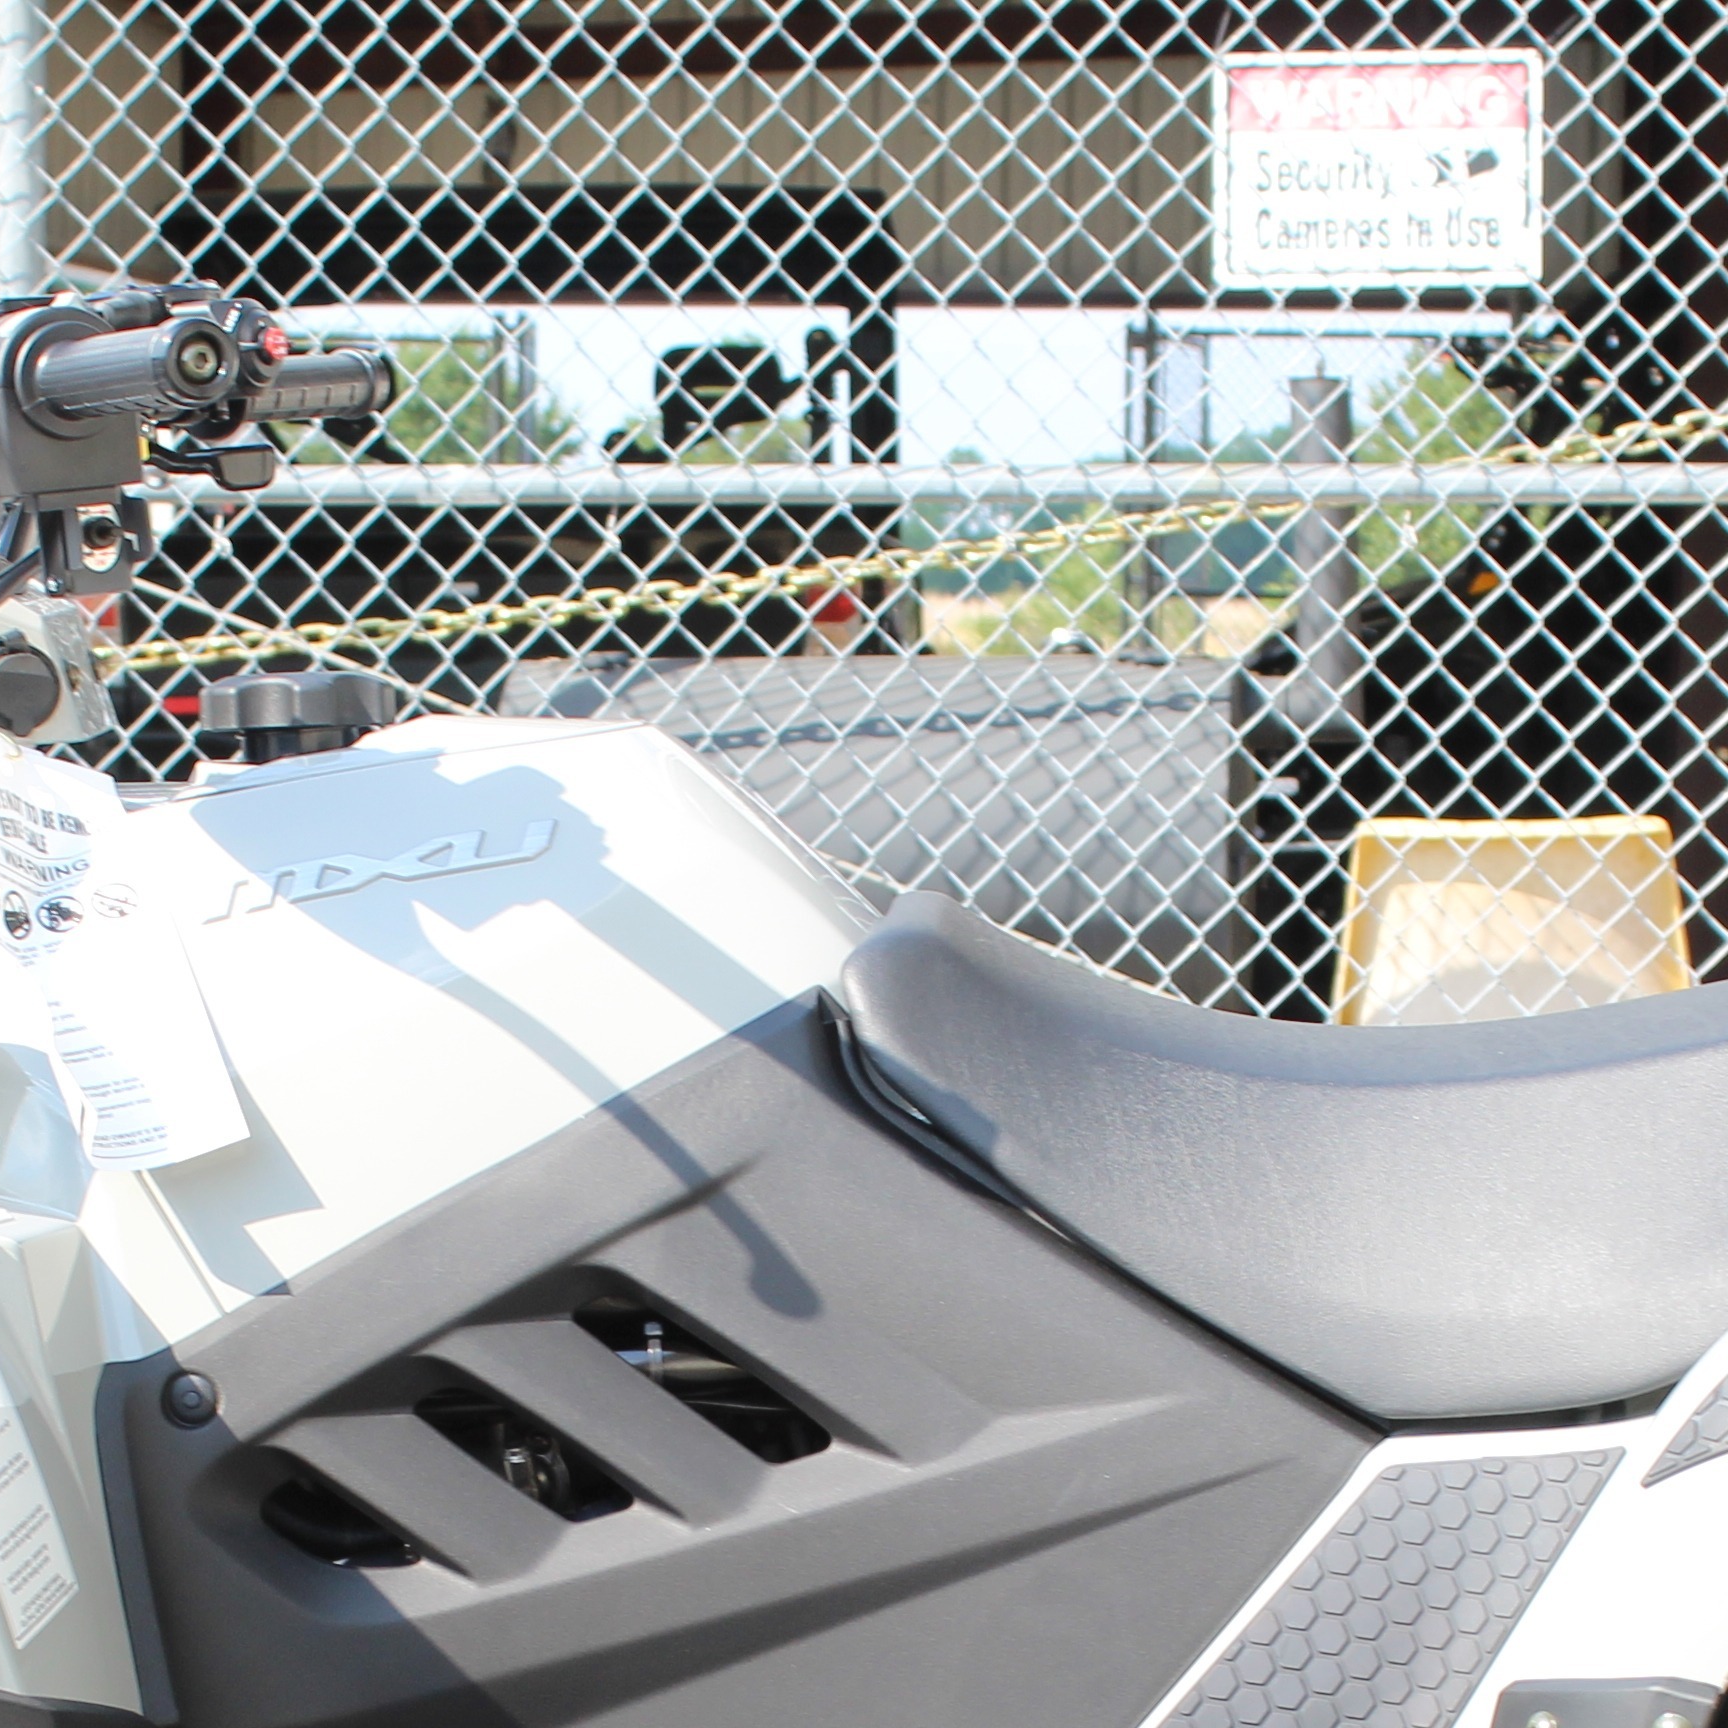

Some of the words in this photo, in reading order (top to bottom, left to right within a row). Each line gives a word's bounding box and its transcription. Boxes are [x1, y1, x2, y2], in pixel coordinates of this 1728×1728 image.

[1245, 76, 1508, 127] WARNING
[1256, 150, 1394, 199] Security
[1256, 208, 1390, 249] Cameras
[1446, 207, 1502, 248] Use
[0, 846, 91, 883] WARNING
